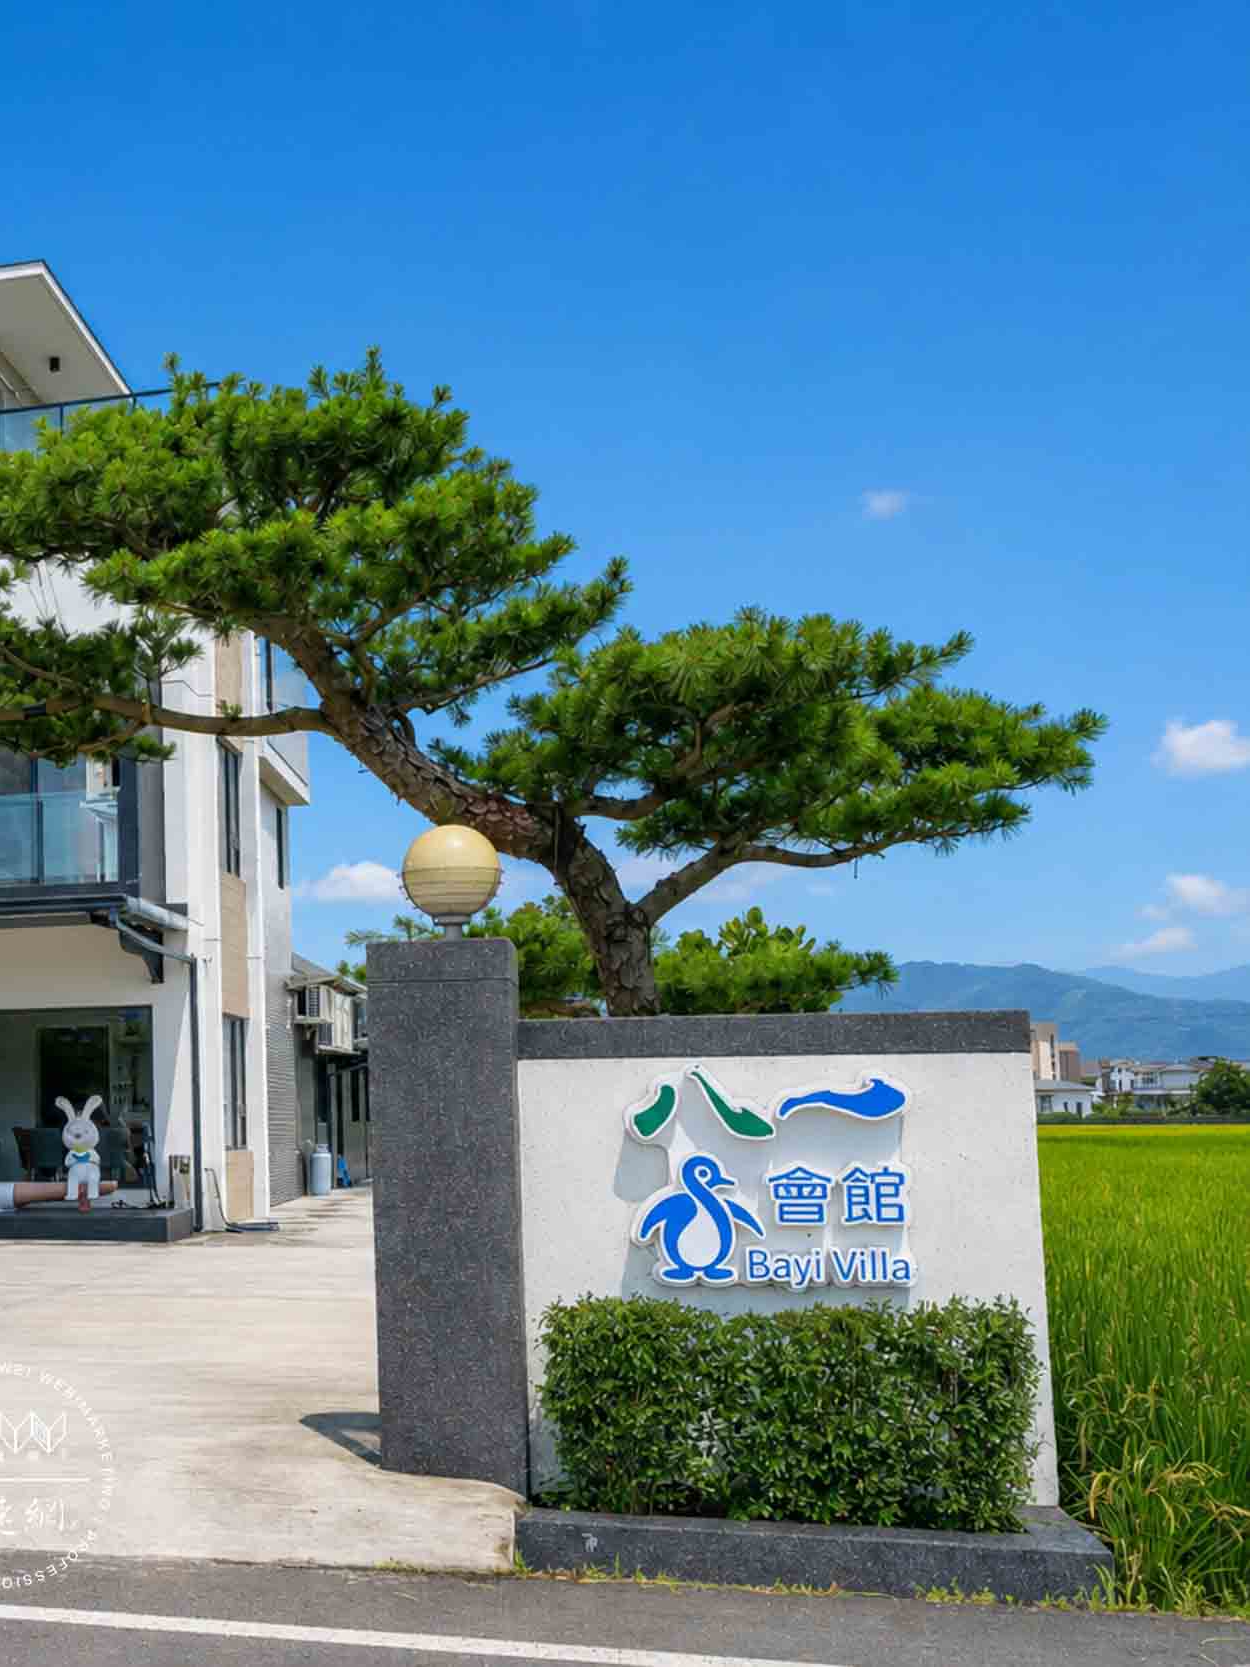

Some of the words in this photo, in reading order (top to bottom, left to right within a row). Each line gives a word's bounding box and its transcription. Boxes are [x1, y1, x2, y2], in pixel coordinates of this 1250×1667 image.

[767, 1166, 905, 1224] 會館
[748, 1250, 822, 1287] Bayi
[831, 1249, 911, 1281] Villa
